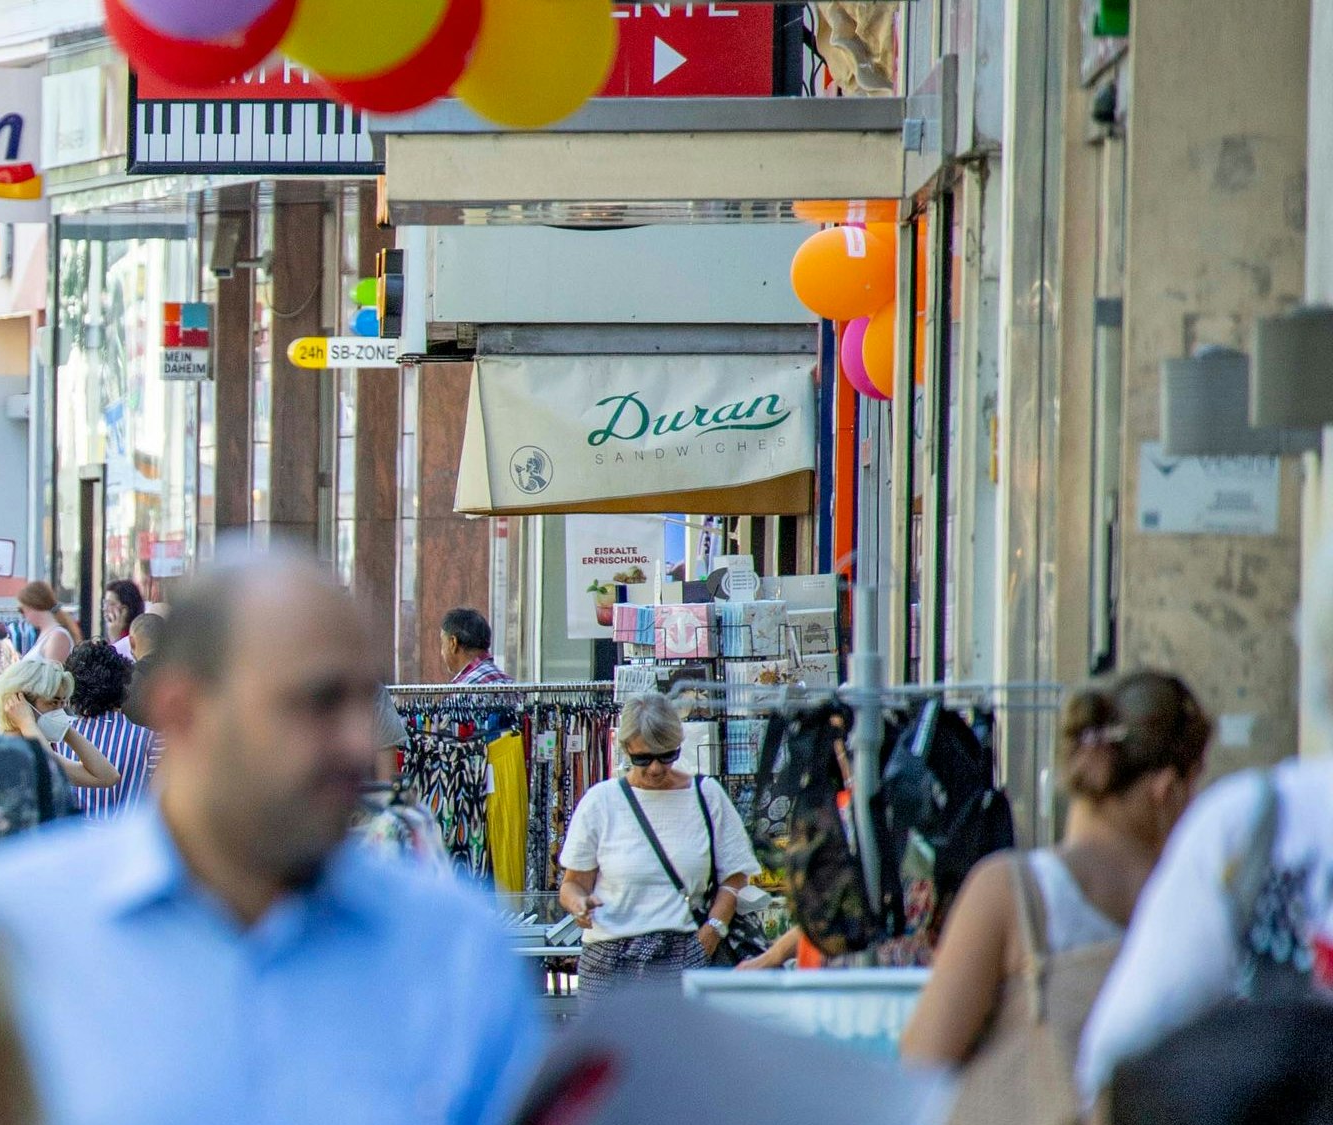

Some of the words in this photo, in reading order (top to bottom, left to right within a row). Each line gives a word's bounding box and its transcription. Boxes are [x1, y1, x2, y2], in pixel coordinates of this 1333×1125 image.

[164, 351, 192, 363] MEIN
[299, 345, 324, 361] 24h
[330, 344, 396, 361] SB-ZONE
[164, 362, 206, 374] DAHEIM
[587, 391, 791, 446] Duran
[594, 437, 787, 465] SANDWICHES
[594, 547, 638, 556] EISKALTE
[582, 556, 650, 565] ERFRISCHUNG.
